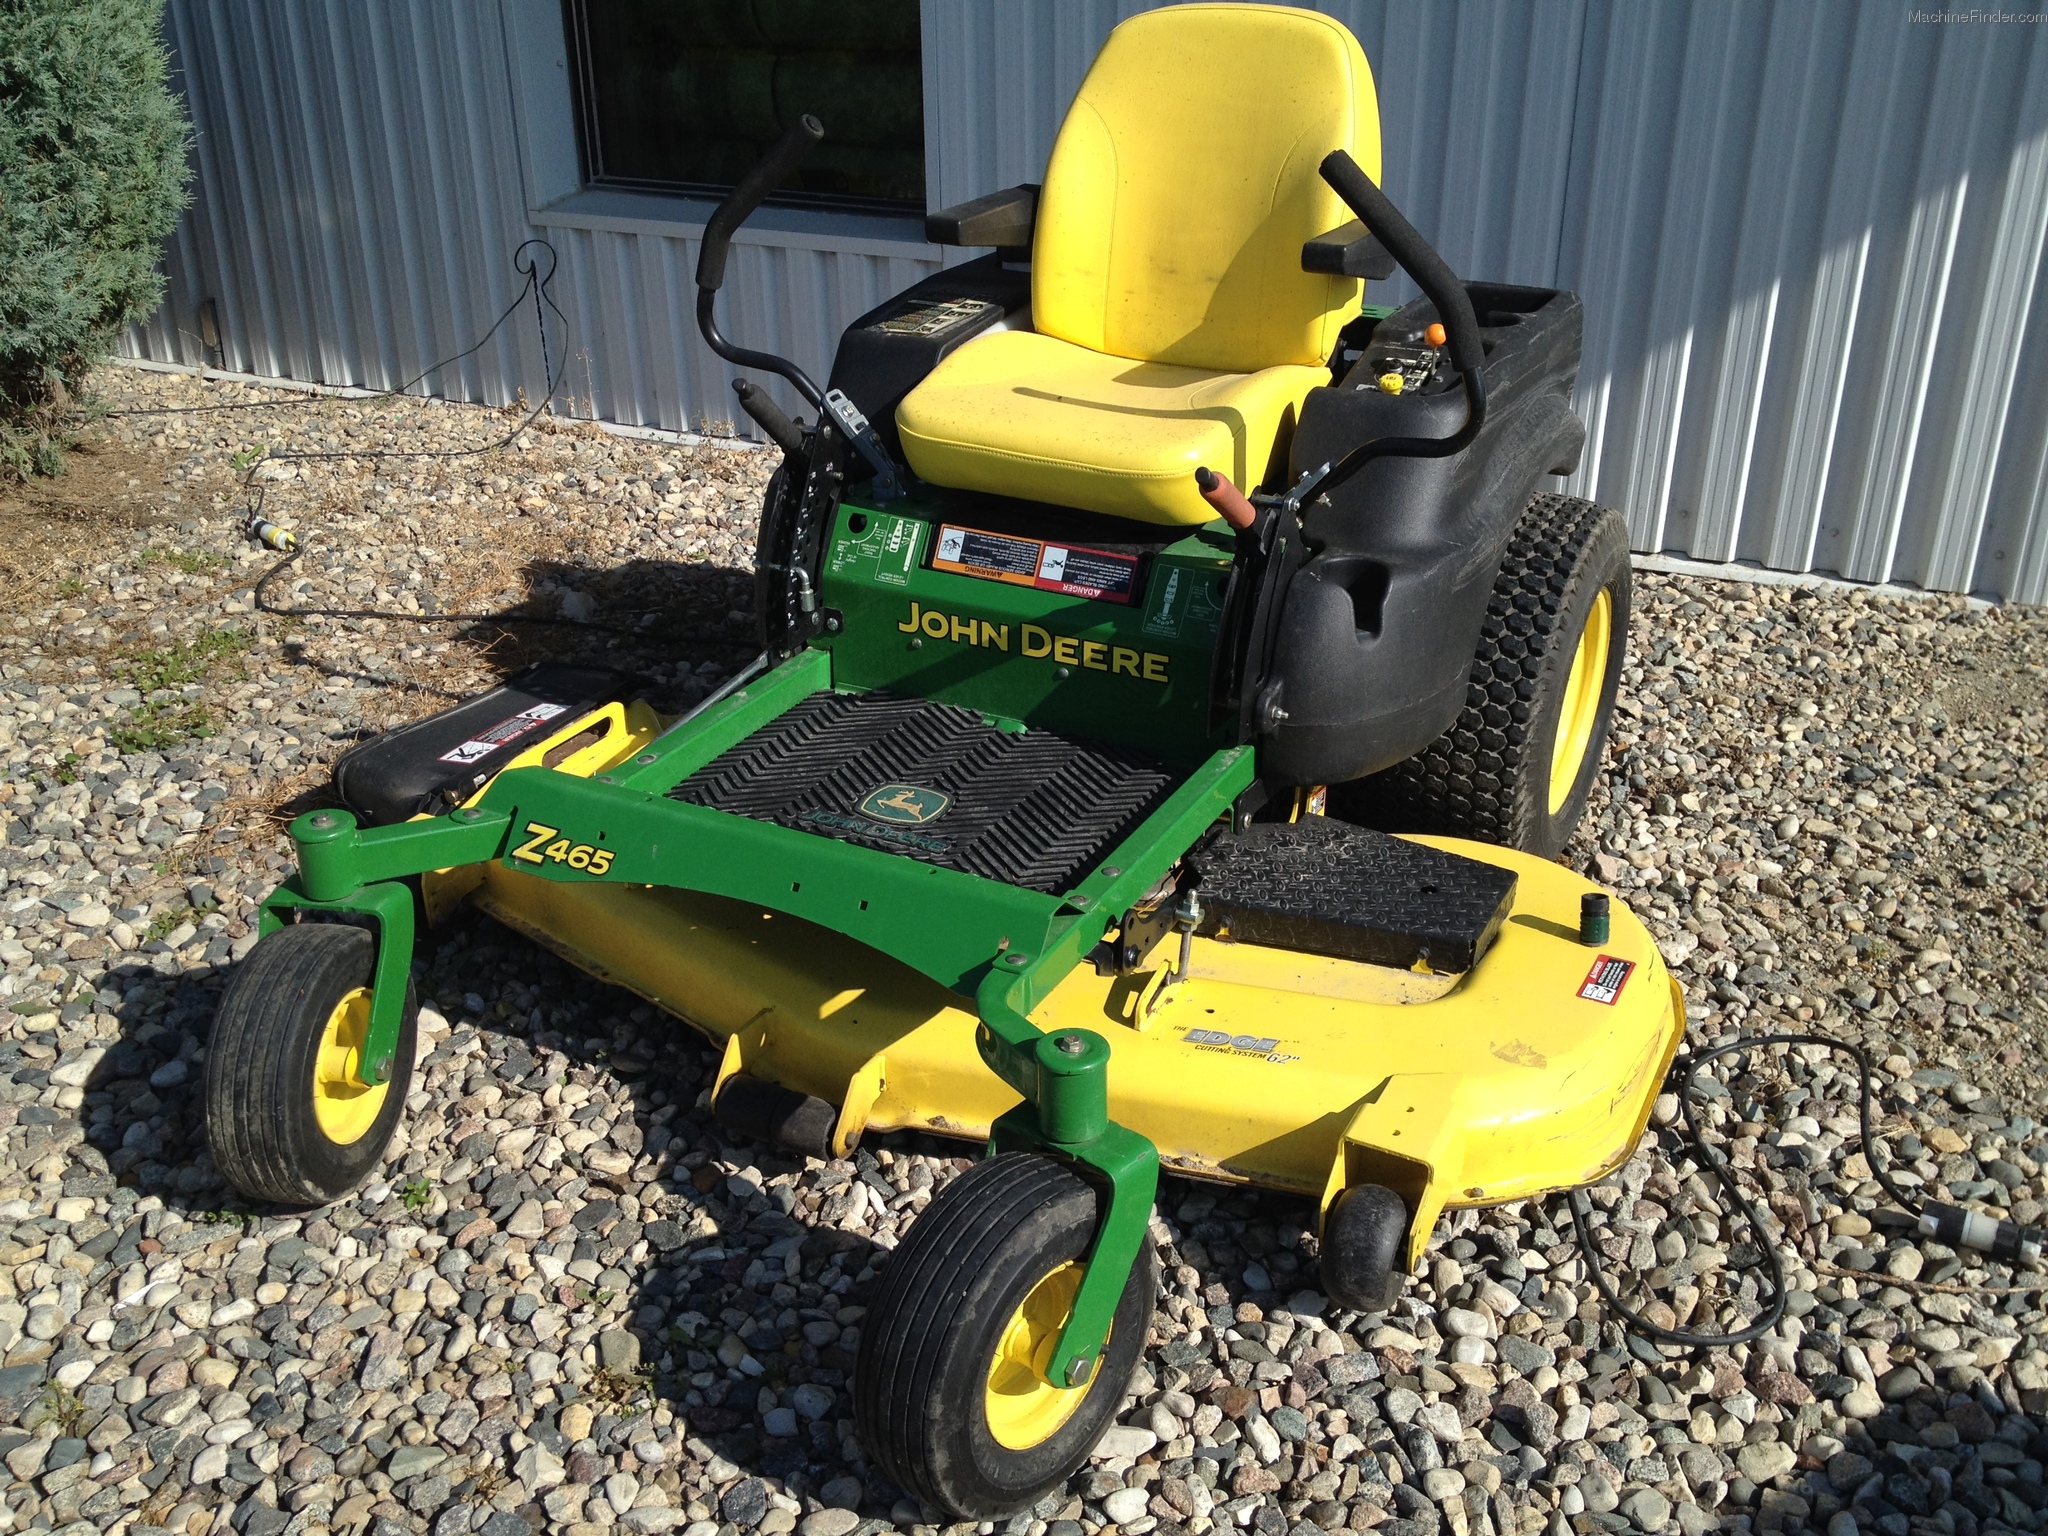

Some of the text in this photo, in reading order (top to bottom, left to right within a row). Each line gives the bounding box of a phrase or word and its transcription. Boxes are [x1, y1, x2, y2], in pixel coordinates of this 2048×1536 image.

[963, 565, 997, 577] WARNING
[1062, 583, 1093, 595] DANGER
[897, 602, 1170, 683] JOHN DEERE
[799, 811, 947, 852] JOHN DEERE
[510, 820, 616, 875] Z465
[1181, 1028, 1280, 1052] EDGE
[1194, 1044, 1301, 1064] CUTTING SYSTEM 62"
